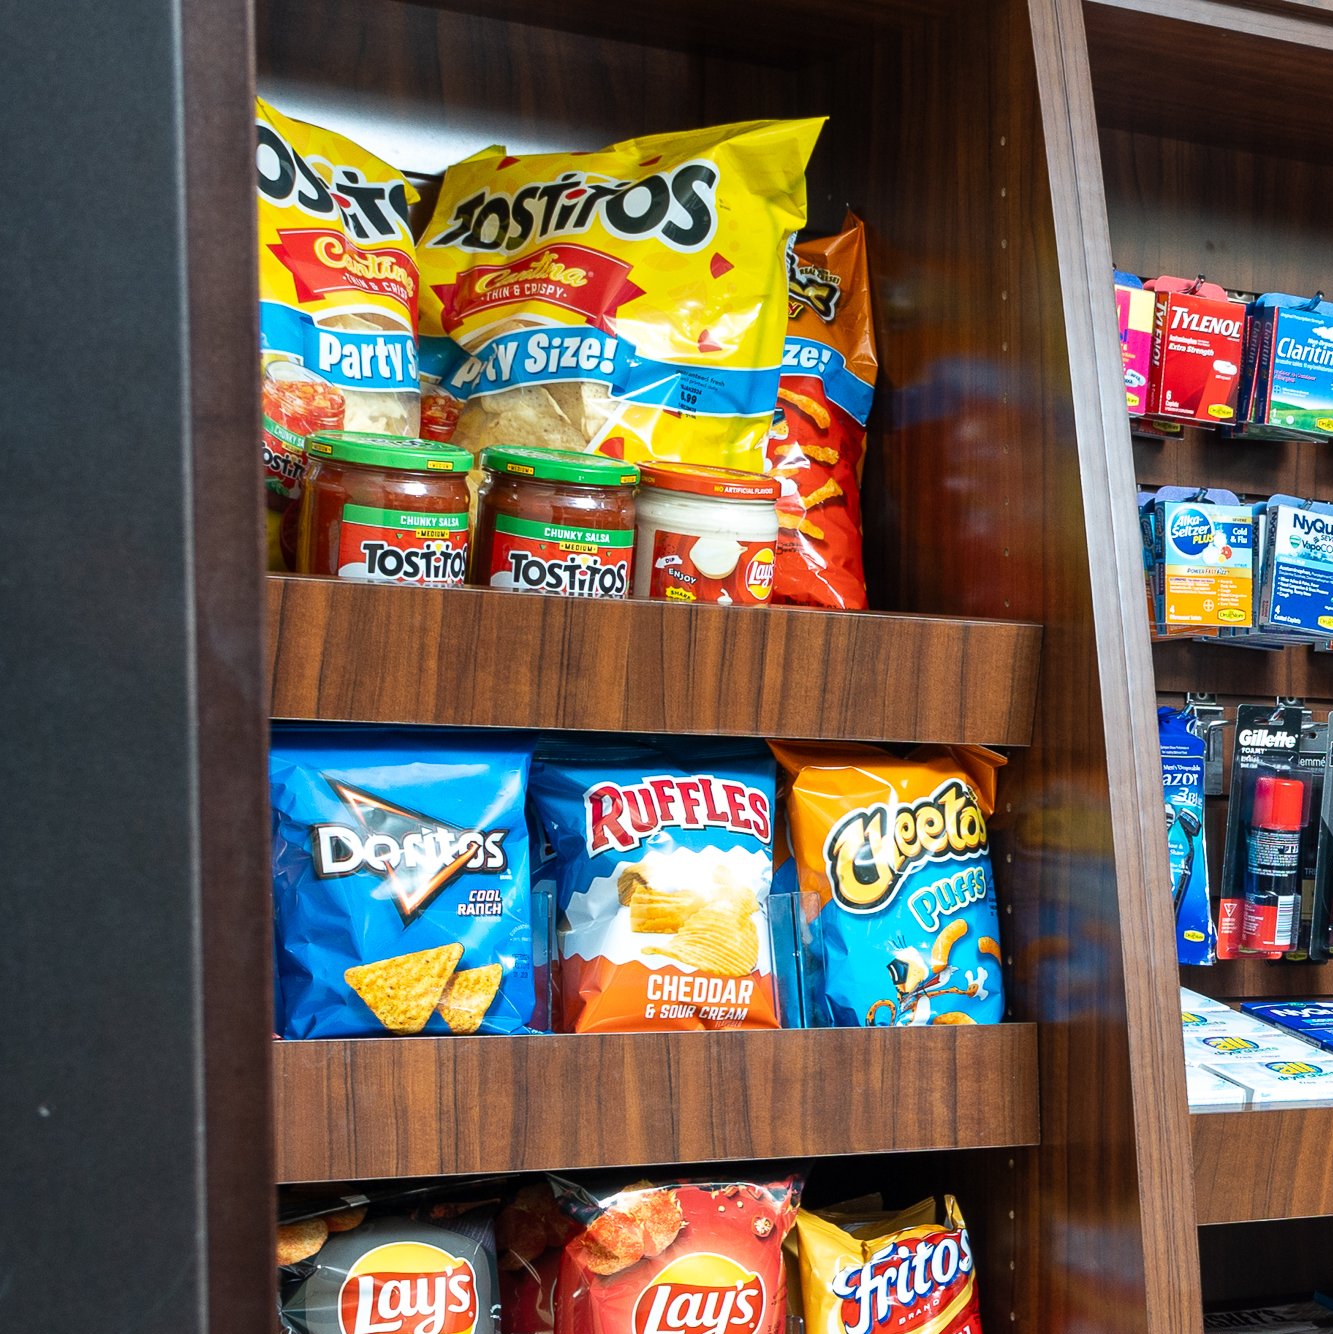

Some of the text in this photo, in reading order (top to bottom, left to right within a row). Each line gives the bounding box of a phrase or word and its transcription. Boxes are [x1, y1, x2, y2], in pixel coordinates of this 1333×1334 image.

[1170, 304, 1242, 340] TYLENOL
[1168, 343, 1186, 354] Extra
[319, 331, 403, 383] Party
[725, 486, 754, 495] ARTIFICIAL
[401, 515, 459, 528] CHUNKY SALSA
[1175, 513, 1203, 529] Alka-
[544, 527, 610, 544] CHUNKY SALSA
[1171, 525, 1211, 540] Seltzer
[1193, 533, 1215, 545] PLUS
[1232, 527, 1248, 536] Cold
[564, 543, 593, 552] MEDIUM
[1230, 536, 1248, 544] & Flu
[668, 567, 698, 585] ENJOY
[1239, 729, 1296, 749] Gillette
[587, 777, 771, 851] RUFFLES
[316, 825, 506, 875] Doritos
[468, 889, 502, 903] COOL
[457, 902, 502, 917] RANCH
[646, 974, 755, 1005] CHEDDAR
[645, 1004, 749, 1022] & SOUR CREAM
[898, 1298, 940, 1326] BRAND
